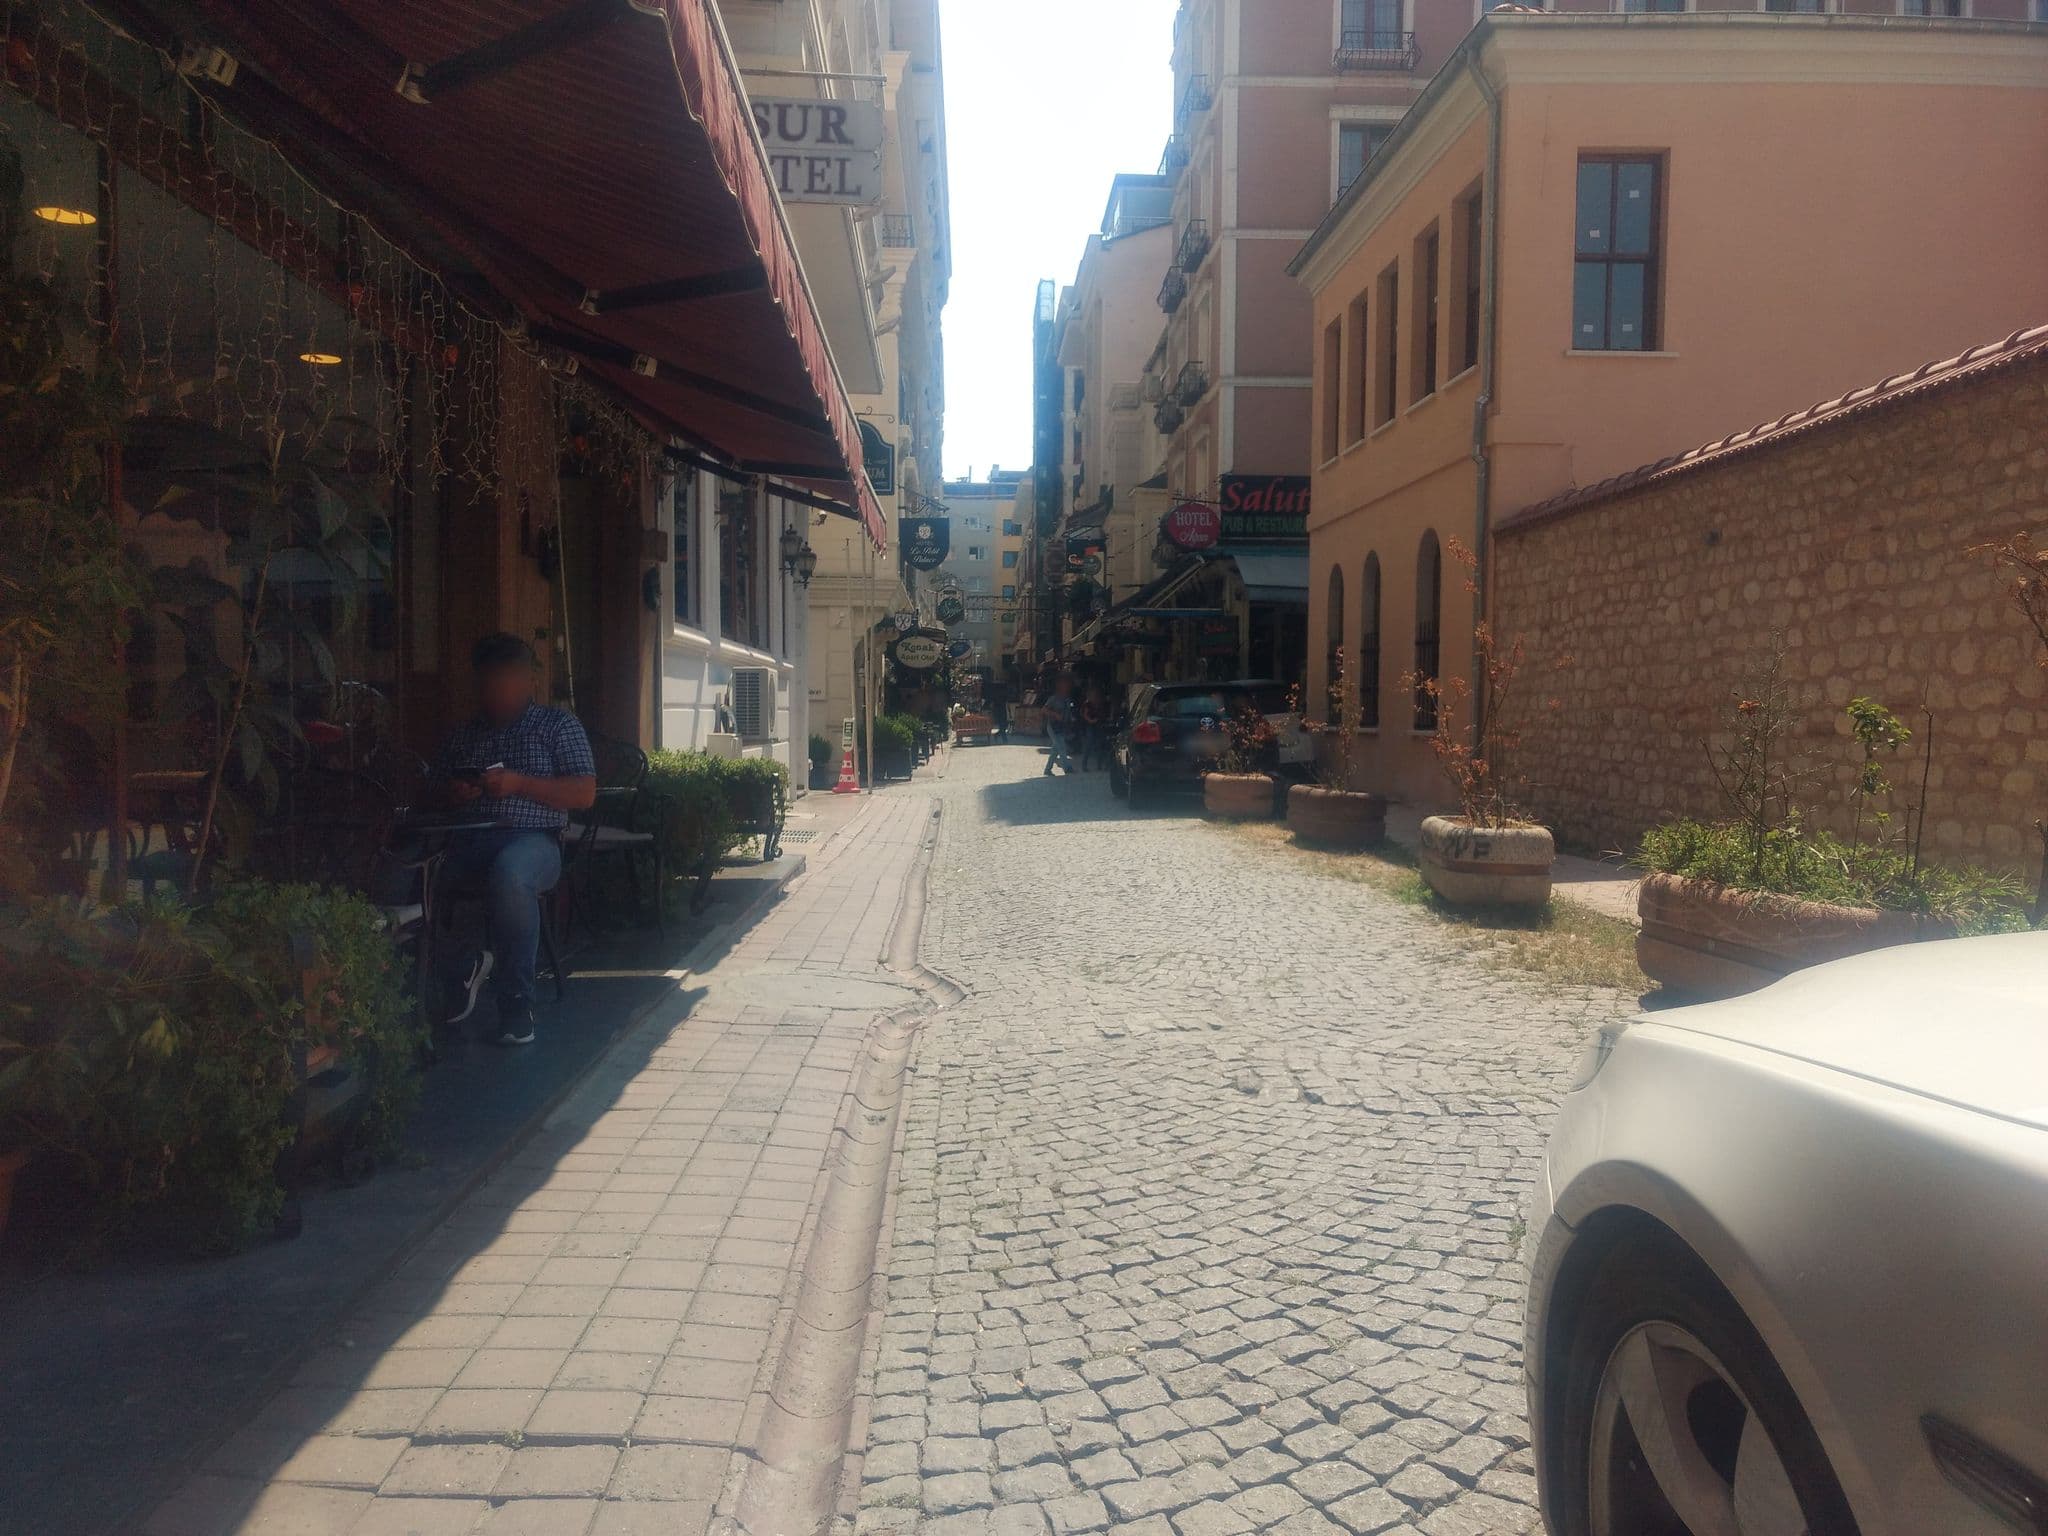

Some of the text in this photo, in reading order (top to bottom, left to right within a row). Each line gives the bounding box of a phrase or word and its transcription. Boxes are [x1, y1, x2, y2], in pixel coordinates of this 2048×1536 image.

[769, 154, 862, 196] TEL
[1175, 512, 1213, 526] HOTEL
[1255, 516, 1304, 532] RESTAUR
[901, 642, 935, 652] Konak
[901, 653, 919, 661] Apart
